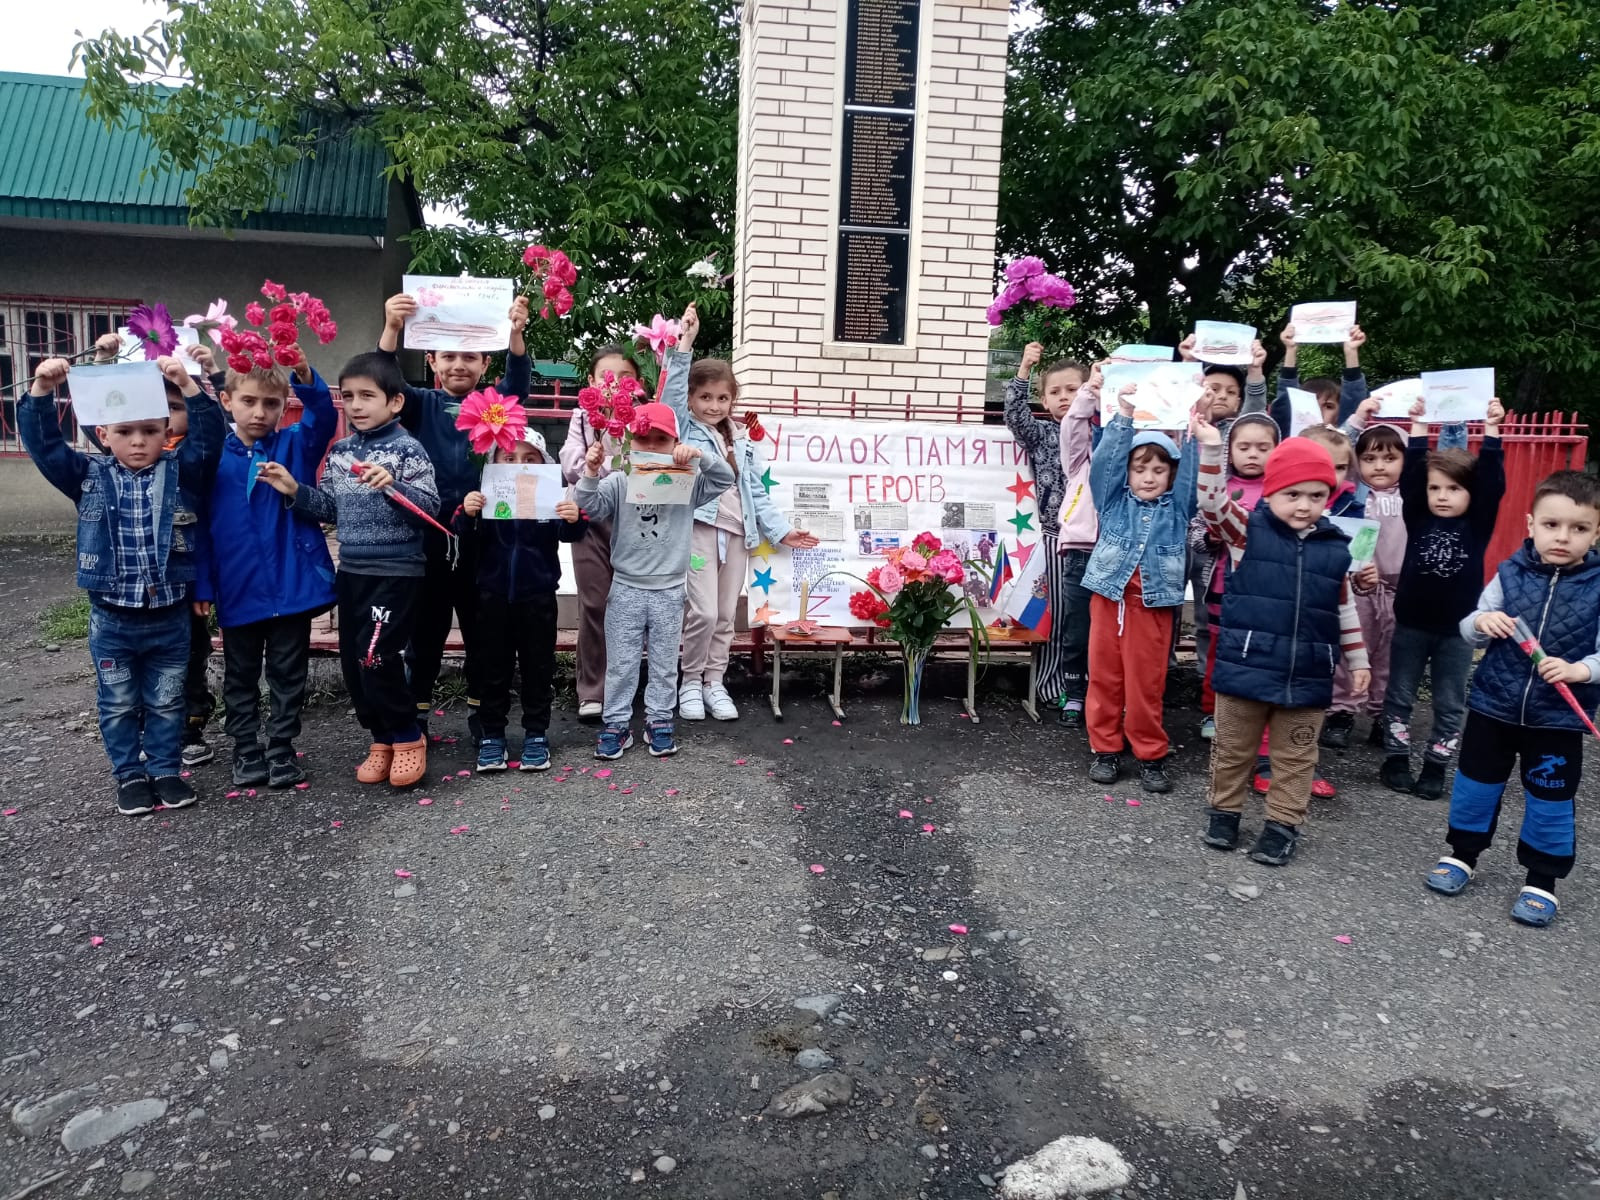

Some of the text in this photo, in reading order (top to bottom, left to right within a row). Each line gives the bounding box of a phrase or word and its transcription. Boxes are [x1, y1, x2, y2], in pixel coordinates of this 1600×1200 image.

[764, 424, 1029, 466] УГОЛОК ПАМЯТИ
[848, 474, 946, 503] ГЕРОЕВ
